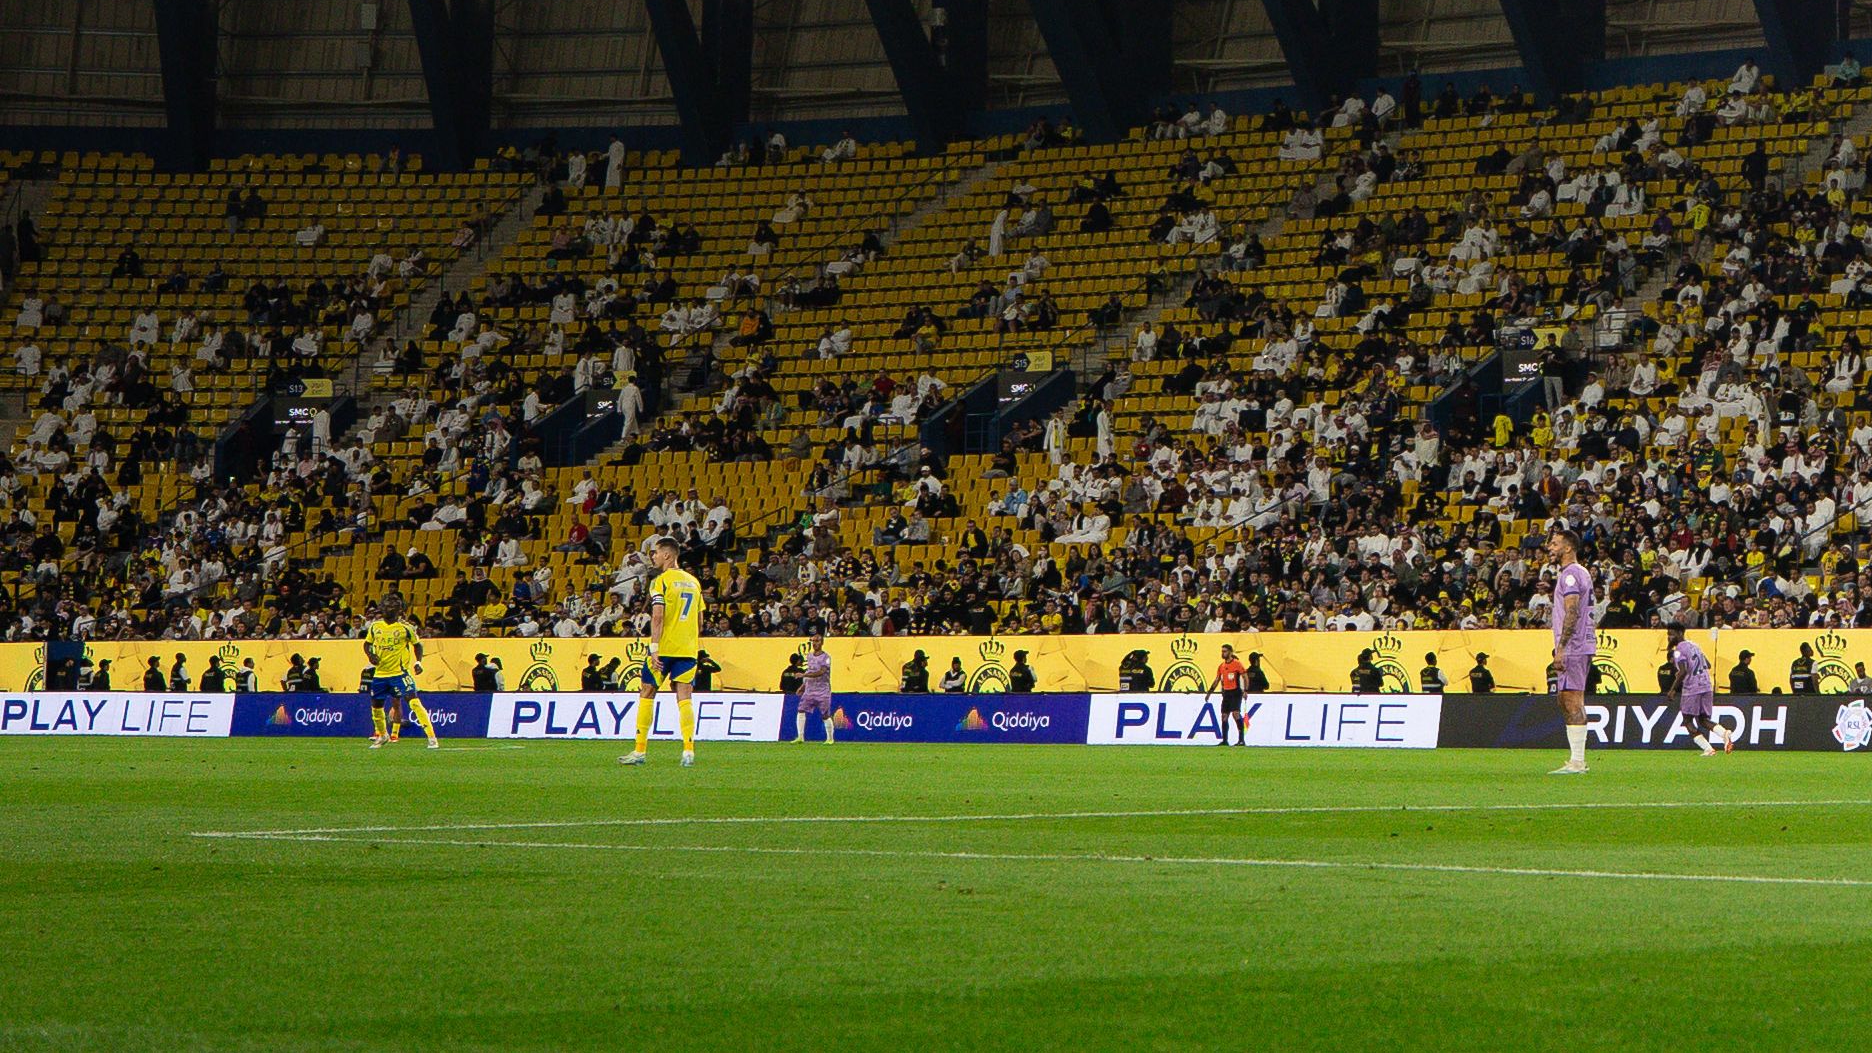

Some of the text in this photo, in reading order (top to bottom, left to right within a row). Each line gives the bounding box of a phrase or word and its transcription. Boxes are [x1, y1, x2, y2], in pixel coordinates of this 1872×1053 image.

[1520, 335, 1535, 346] S16
[1518, 362, 1538, 373] SMC
[288, 407, 309, 417] SMC
[680, 592, 694, 622] 7
[1, 699, 212, 733] PLAY LIFE
[294, 707, 344, 727] Qiddiya
[511, 701, 756, 736] PLAY LFE
[856, 710, 913, 731] Qiddiya
[991, 711, 1050, 732] Qiddiya
[1284, 703, 1408, 742] LIFE
